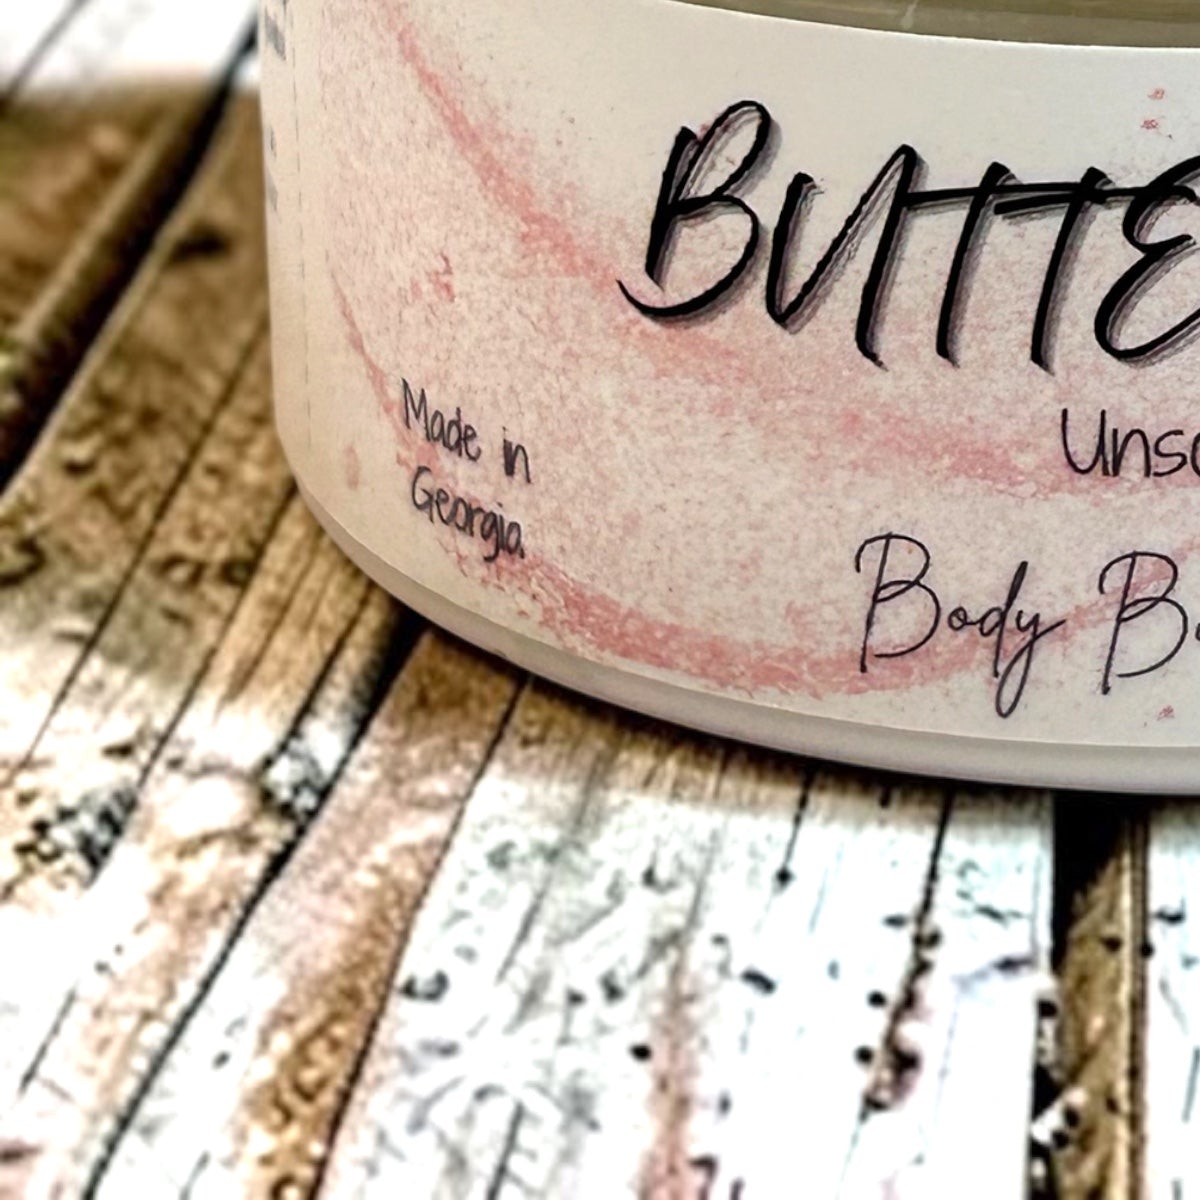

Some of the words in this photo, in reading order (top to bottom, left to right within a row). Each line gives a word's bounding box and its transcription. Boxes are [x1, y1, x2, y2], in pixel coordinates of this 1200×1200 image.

[402, 377, 482, 463] Made
[502, 425, 532, 484] in
[411, 465, 525, 562] Georgia
[853, 531, 1066, 719] Body
